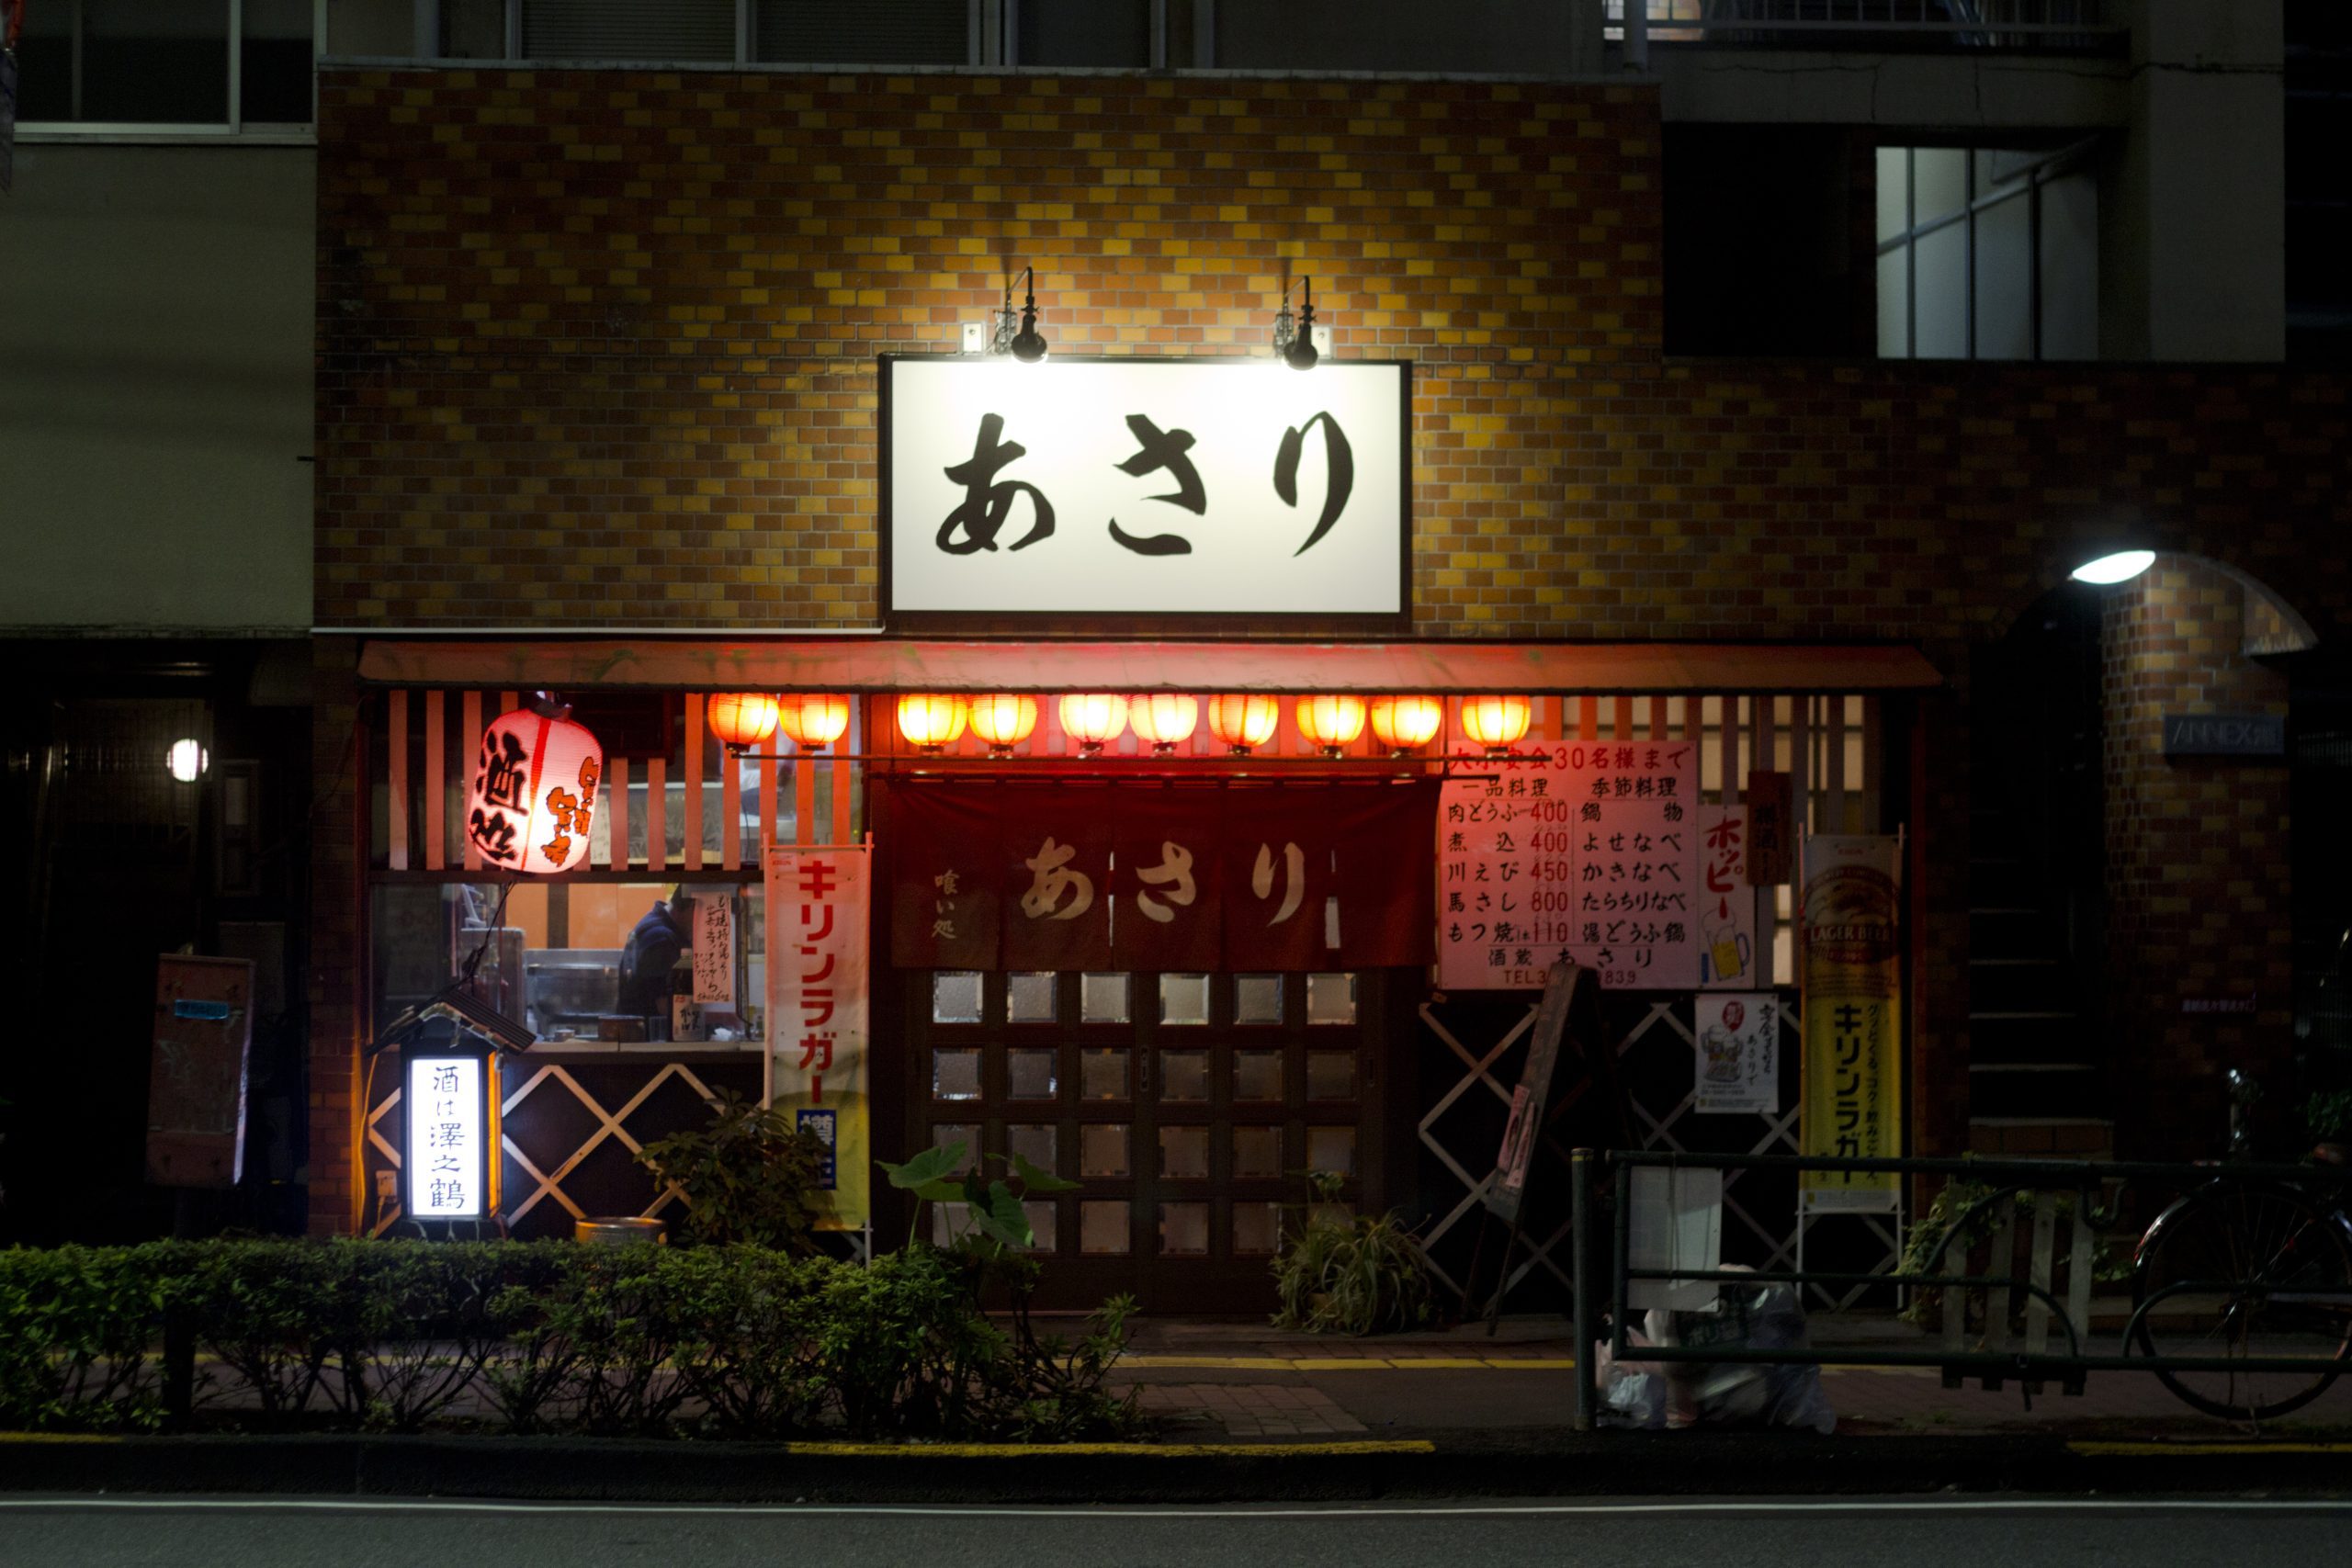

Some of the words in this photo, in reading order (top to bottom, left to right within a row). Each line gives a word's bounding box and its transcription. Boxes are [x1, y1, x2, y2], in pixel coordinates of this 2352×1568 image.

[935, 411, 1354, 558] あさり
[1463, 778, 1548, 797] 一品料理
[1592, 777, 1678, 798] 季節料理
[1531, 803, 1568, 823] 400
[1531, 832, 1568, 852] 400
[1583, 832, 1681, 852] よせなべ
[1448, 862, 1519, 882] 川えび
[1531, 862, 1568, 882] 450
[1583, 862, 1680, 882] かきなべ
[1703, 815, 1744, 919] ホッピー
[1021, 836, 1305, 927] あさり
[1448, 891, 1518, 912] 馬さし
[1532, 892, 1568, 912] 800
[1583, 891, 1686, 911] たらちりなべ
[1533, 922, 1568, 942] 110
[1810, 926, 1854, 942] LAGER
[1858, 926, 1892, 942] BEER
[799, 861, 837, 1103] キリンラガー
[1835, 1005, 1862, 1184] キリンラガー
[430, 1066, 466, 1209] 酒は澤之鶴
